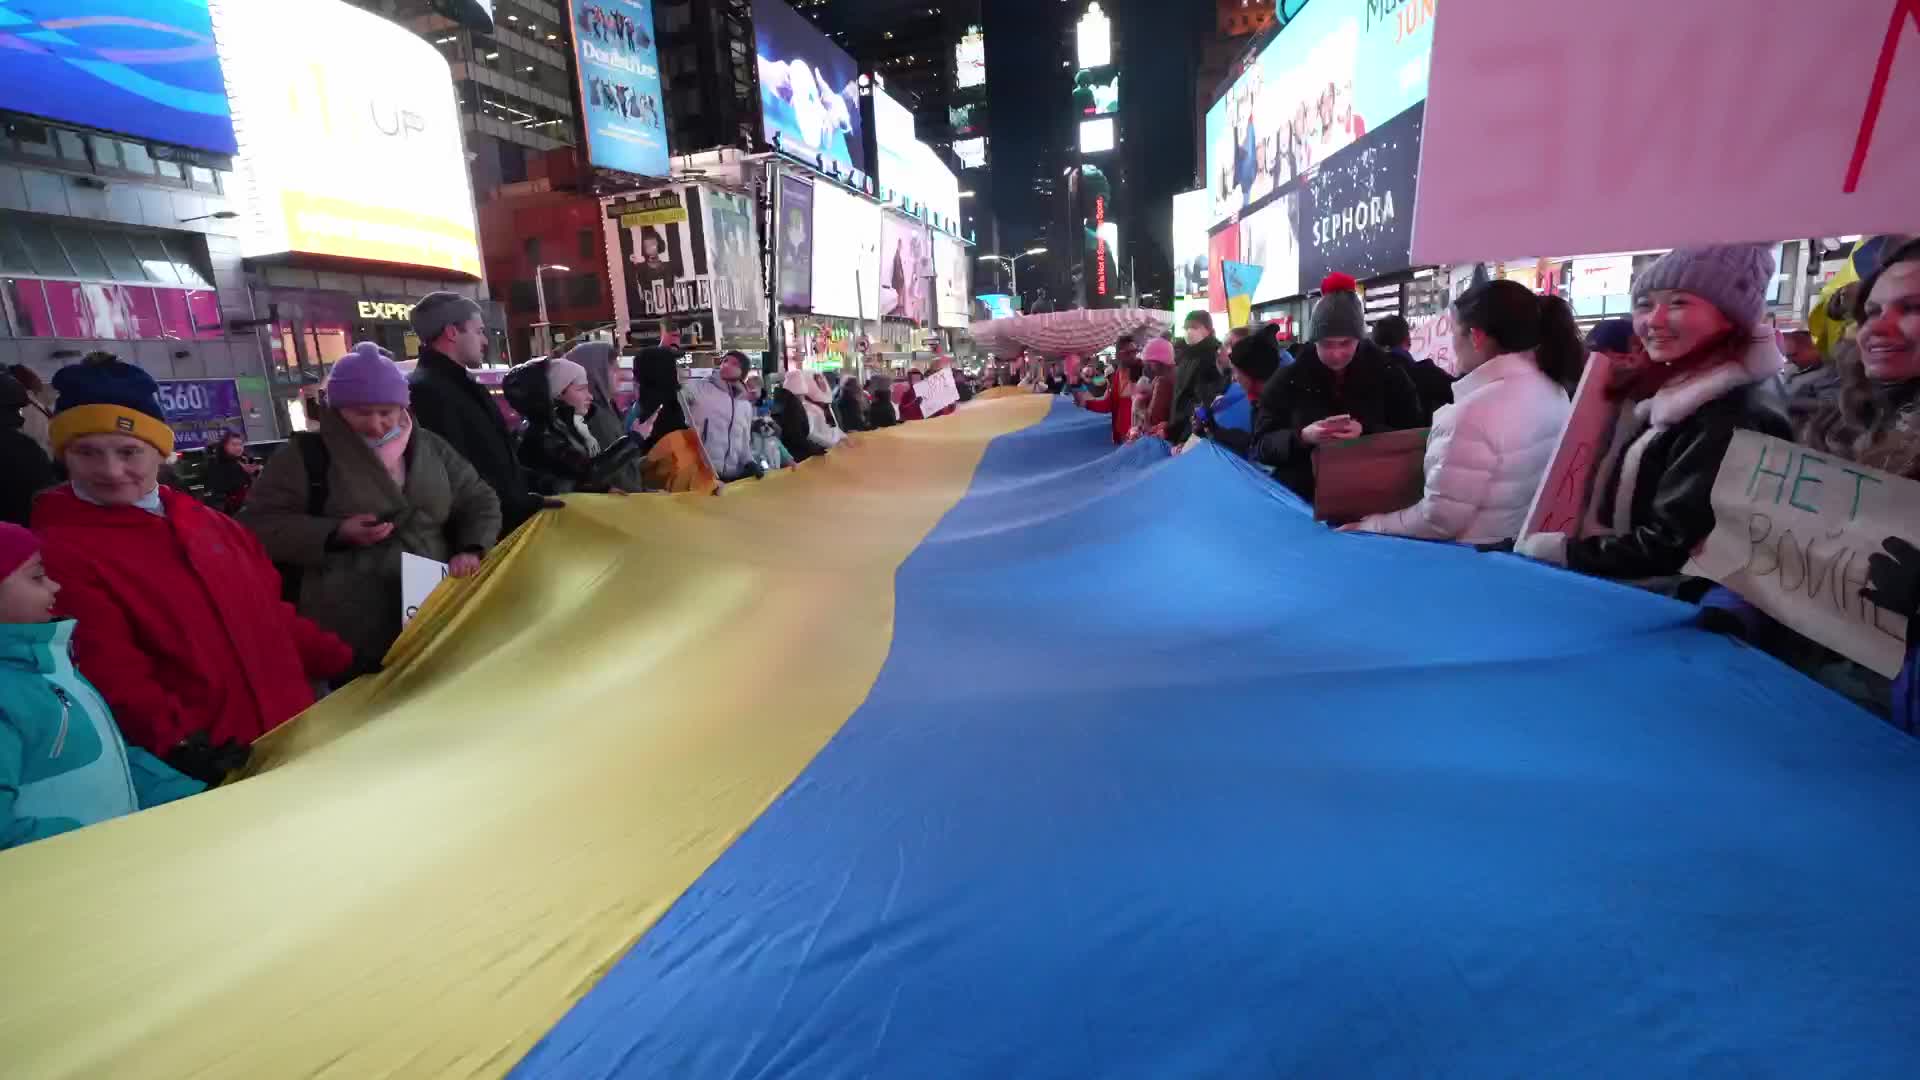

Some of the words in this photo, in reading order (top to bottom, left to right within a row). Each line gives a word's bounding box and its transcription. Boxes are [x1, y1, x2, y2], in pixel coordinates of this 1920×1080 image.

[1313, 190, 1394, 246] SEPHORA
[1097, 262, 1105, 274] Not
[358, 301, 416, 320] EXPR
[1747, 445, 1883, 520] НЕТ
